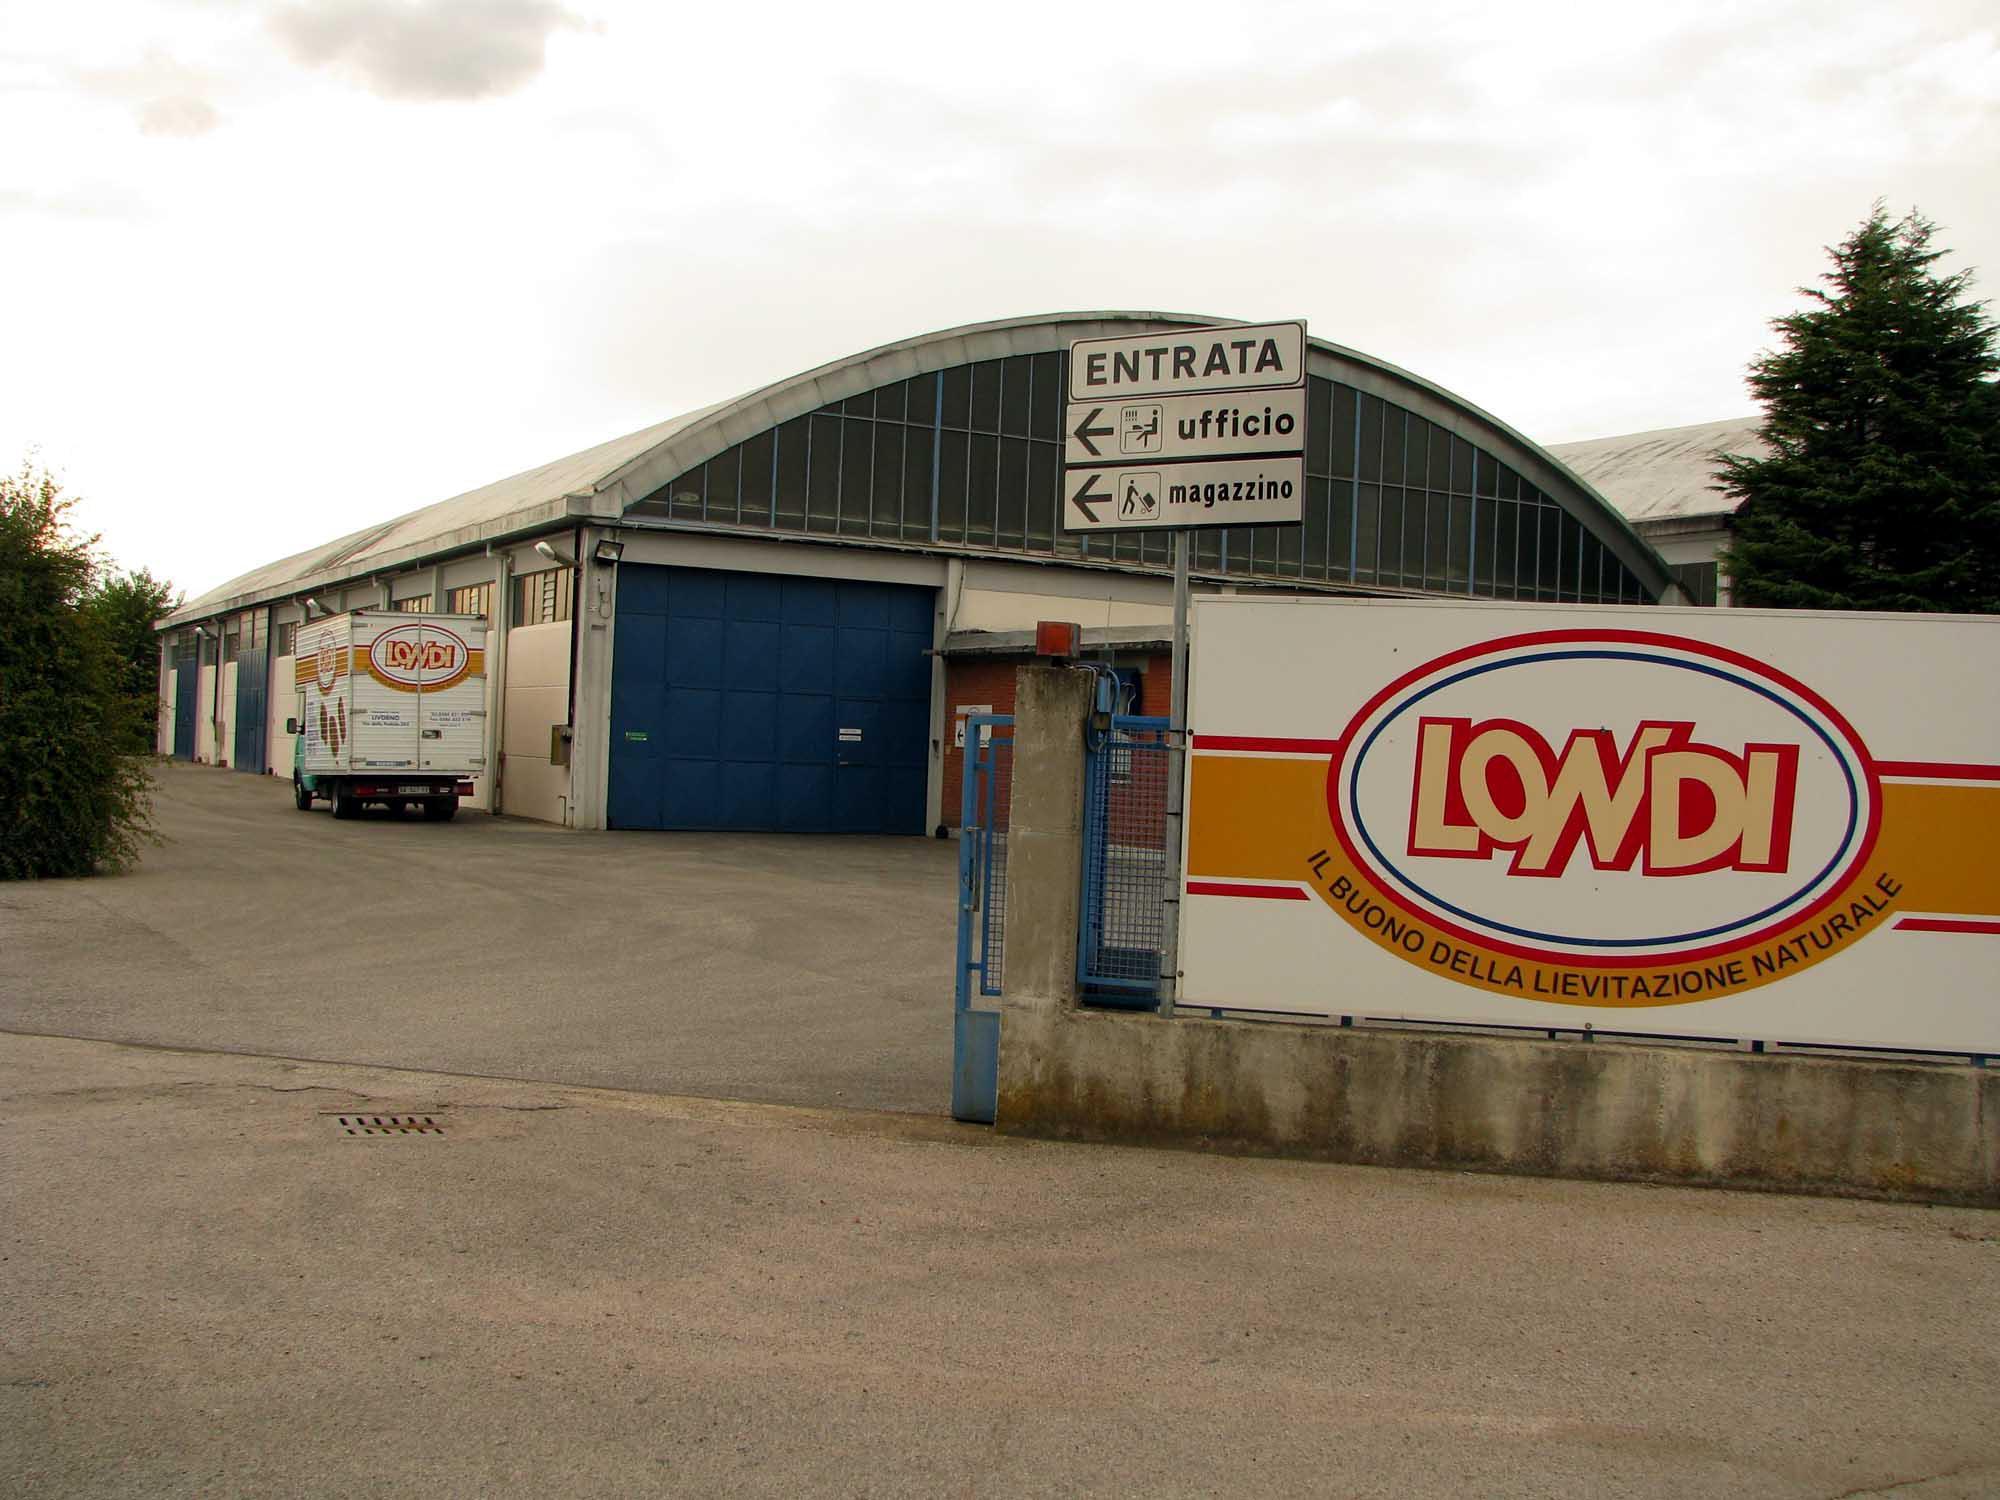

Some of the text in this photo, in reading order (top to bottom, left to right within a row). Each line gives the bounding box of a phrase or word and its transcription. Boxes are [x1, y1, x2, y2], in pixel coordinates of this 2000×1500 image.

[1086, 339, 1283, 386] ENTRATA
[1178, 407, 1295, 440] ufficio
[1169, 474, 1293, 508] magazzino
[385, 641, 456, 670] LONDI
[1407, 717, 1799, 877] LONDI
[1307, 850, 1904, 999] IL BUONO DELLA LIEVITAZIONE NATURALE
